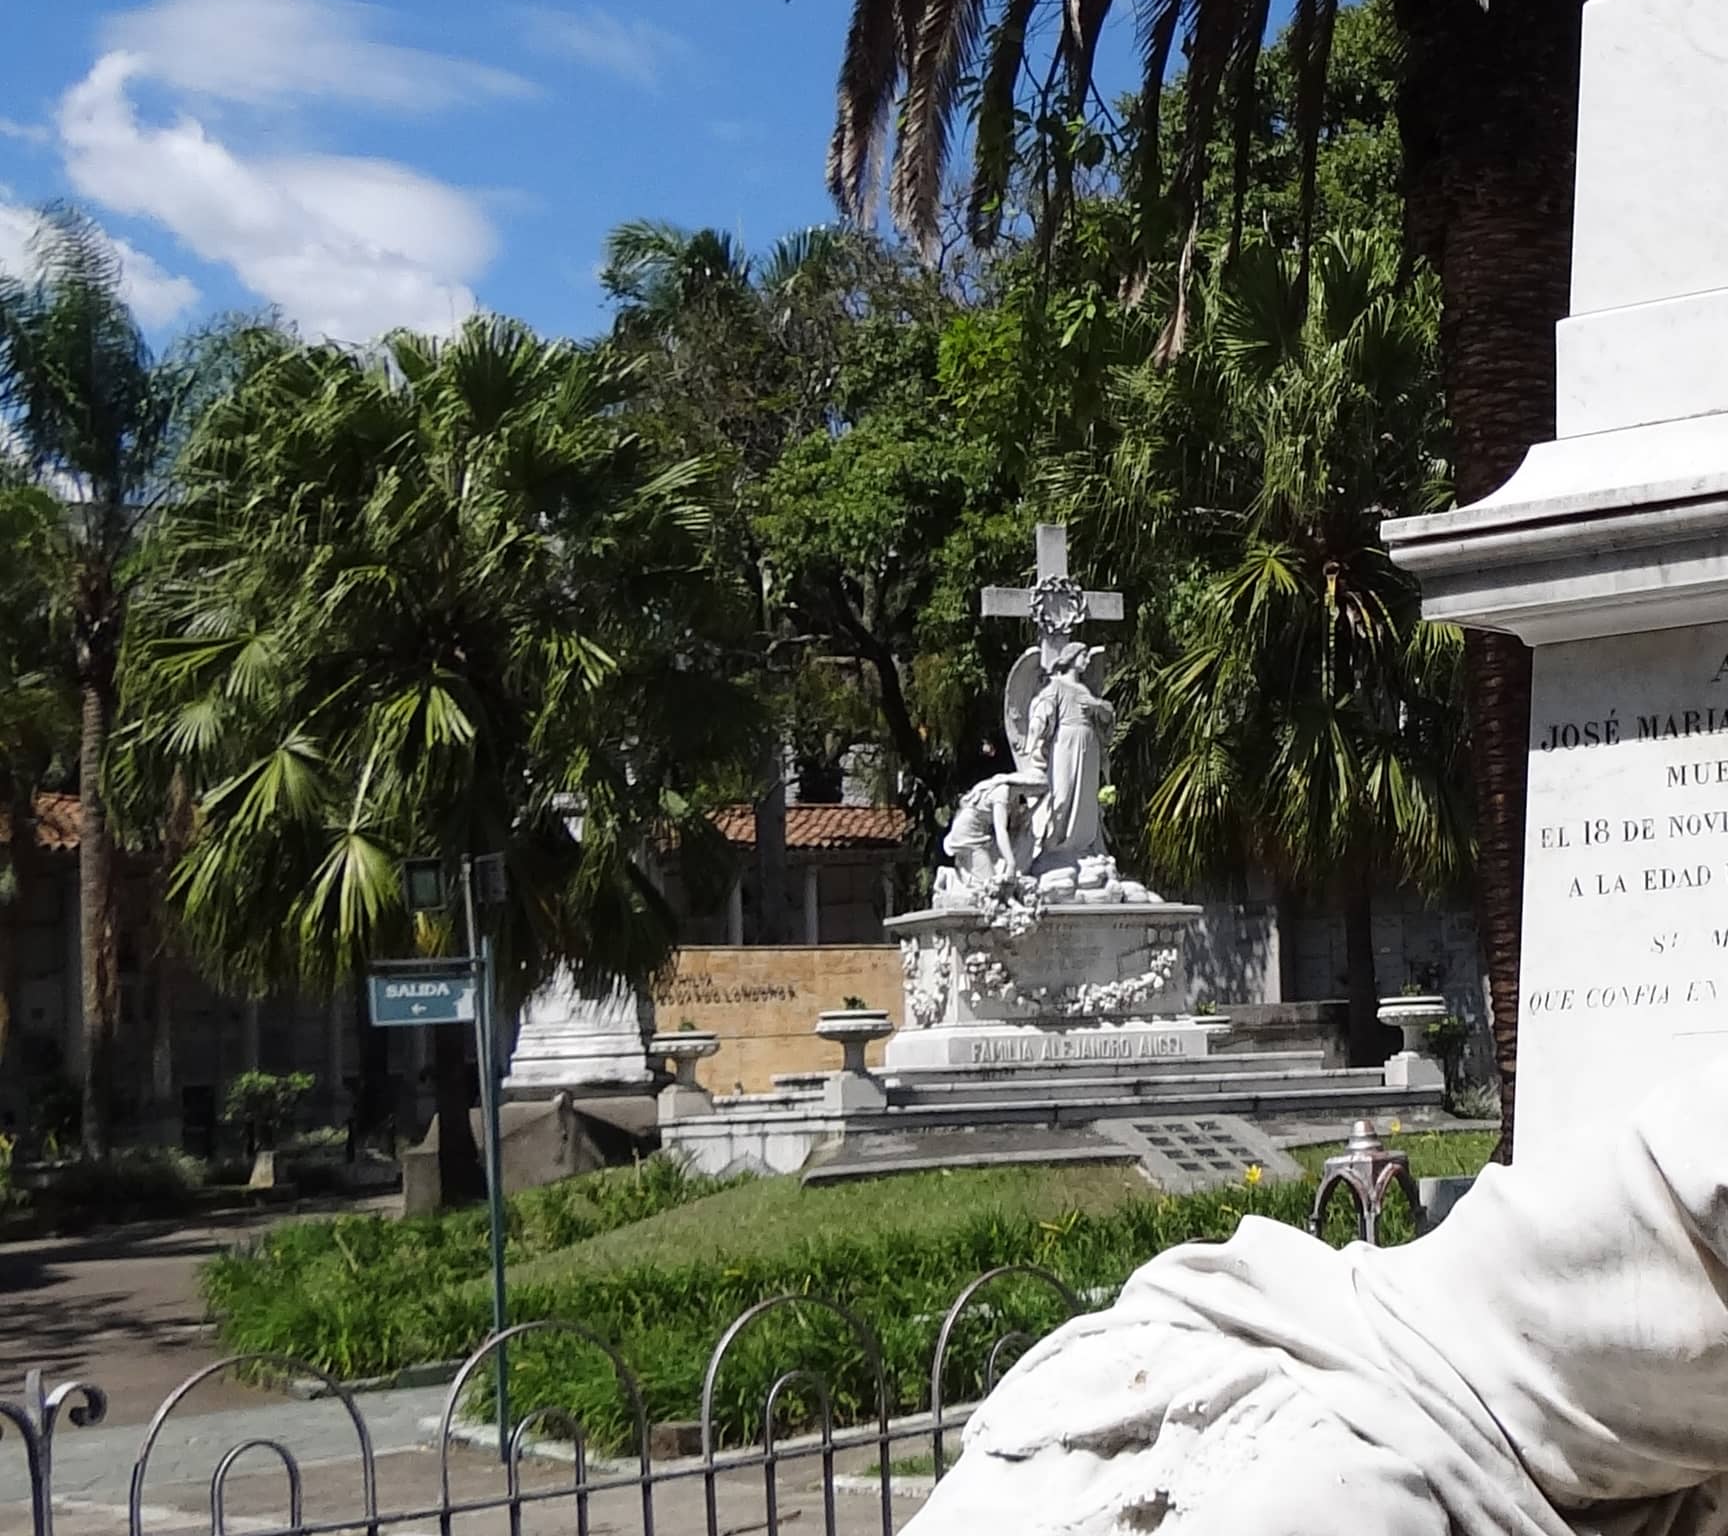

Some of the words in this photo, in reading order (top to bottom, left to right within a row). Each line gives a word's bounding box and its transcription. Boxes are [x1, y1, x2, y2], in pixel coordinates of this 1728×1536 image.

[1540, 709, 1621, 752] JOSÉ
[1540, 827, 1571, 849] EL
[1584, 819, 1611, 845] 18
[1623, 818, 1656, 843] DE
[1568, 877, 1584, 898] A
[1597, 872, 1628, 896] LA
[1643, 864, 1712, 892] EDAD
[384, 982, 450, 999] SALIDA
[1528, 988, 1577, 1017] QUE
[971, 1039, 1033, 1064] FAMILIA
